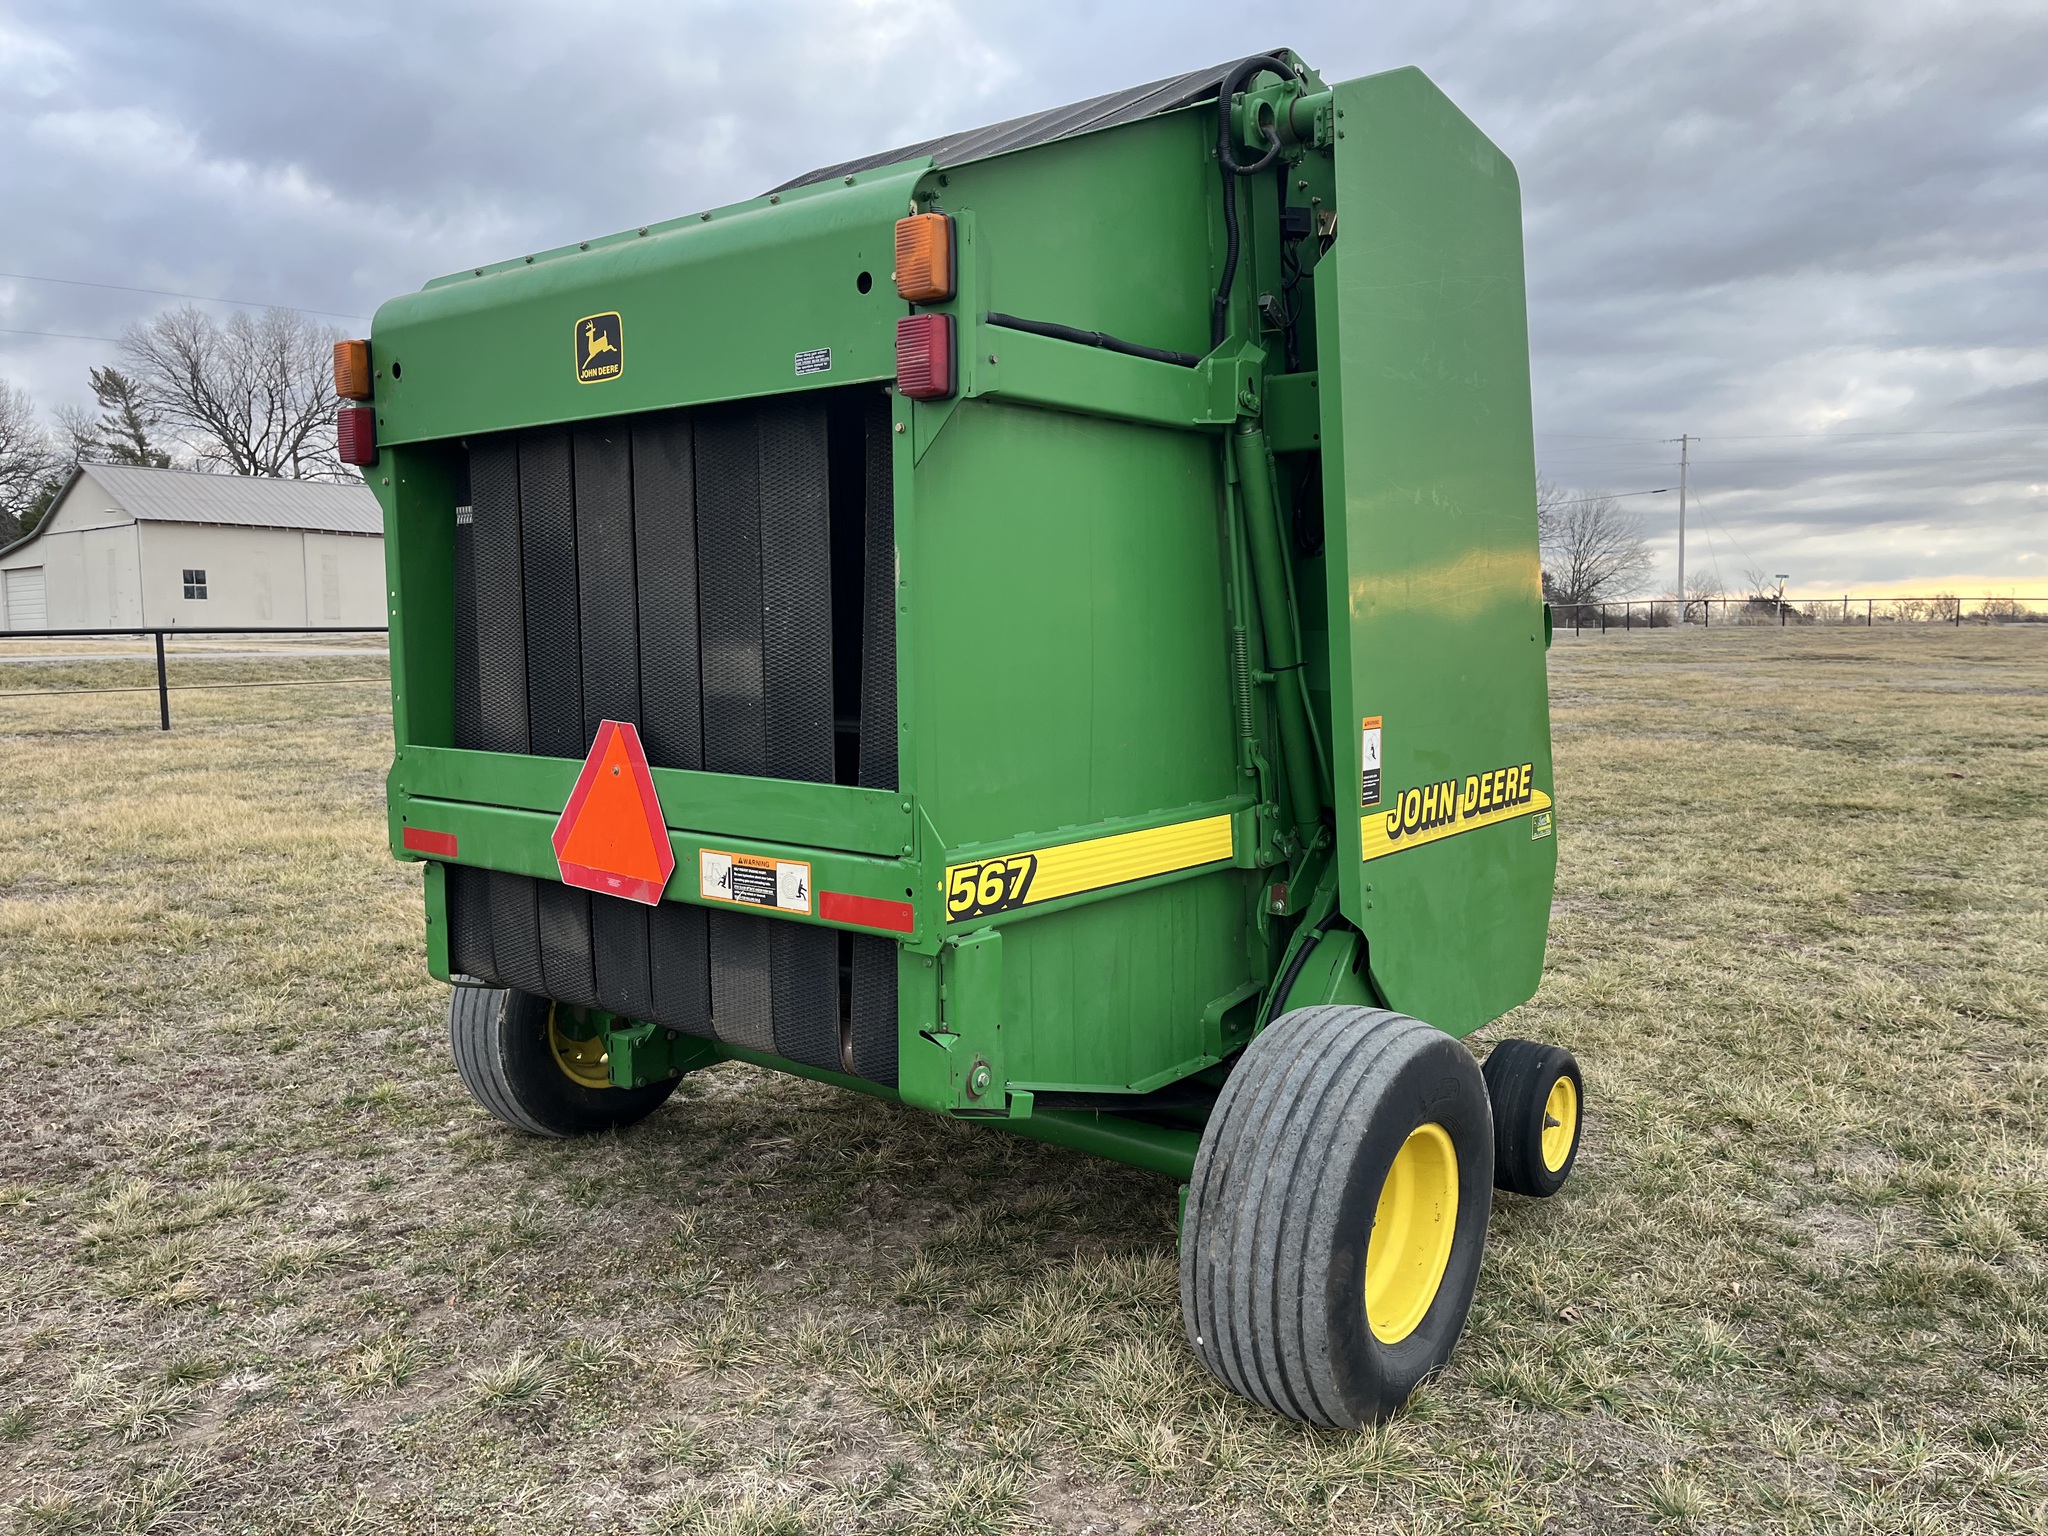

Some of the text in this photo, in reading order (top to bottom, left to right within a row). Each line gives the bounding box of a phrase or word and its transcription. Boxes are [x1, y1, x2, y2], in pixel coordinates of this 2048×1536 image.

[581, 364, 619, 378] JOHN DEERE
[1386, 762, 1532, 838] JOHN DEERE
[743, 858, 770, 868] WARNING
[948, 854, 1037, 914] 567
